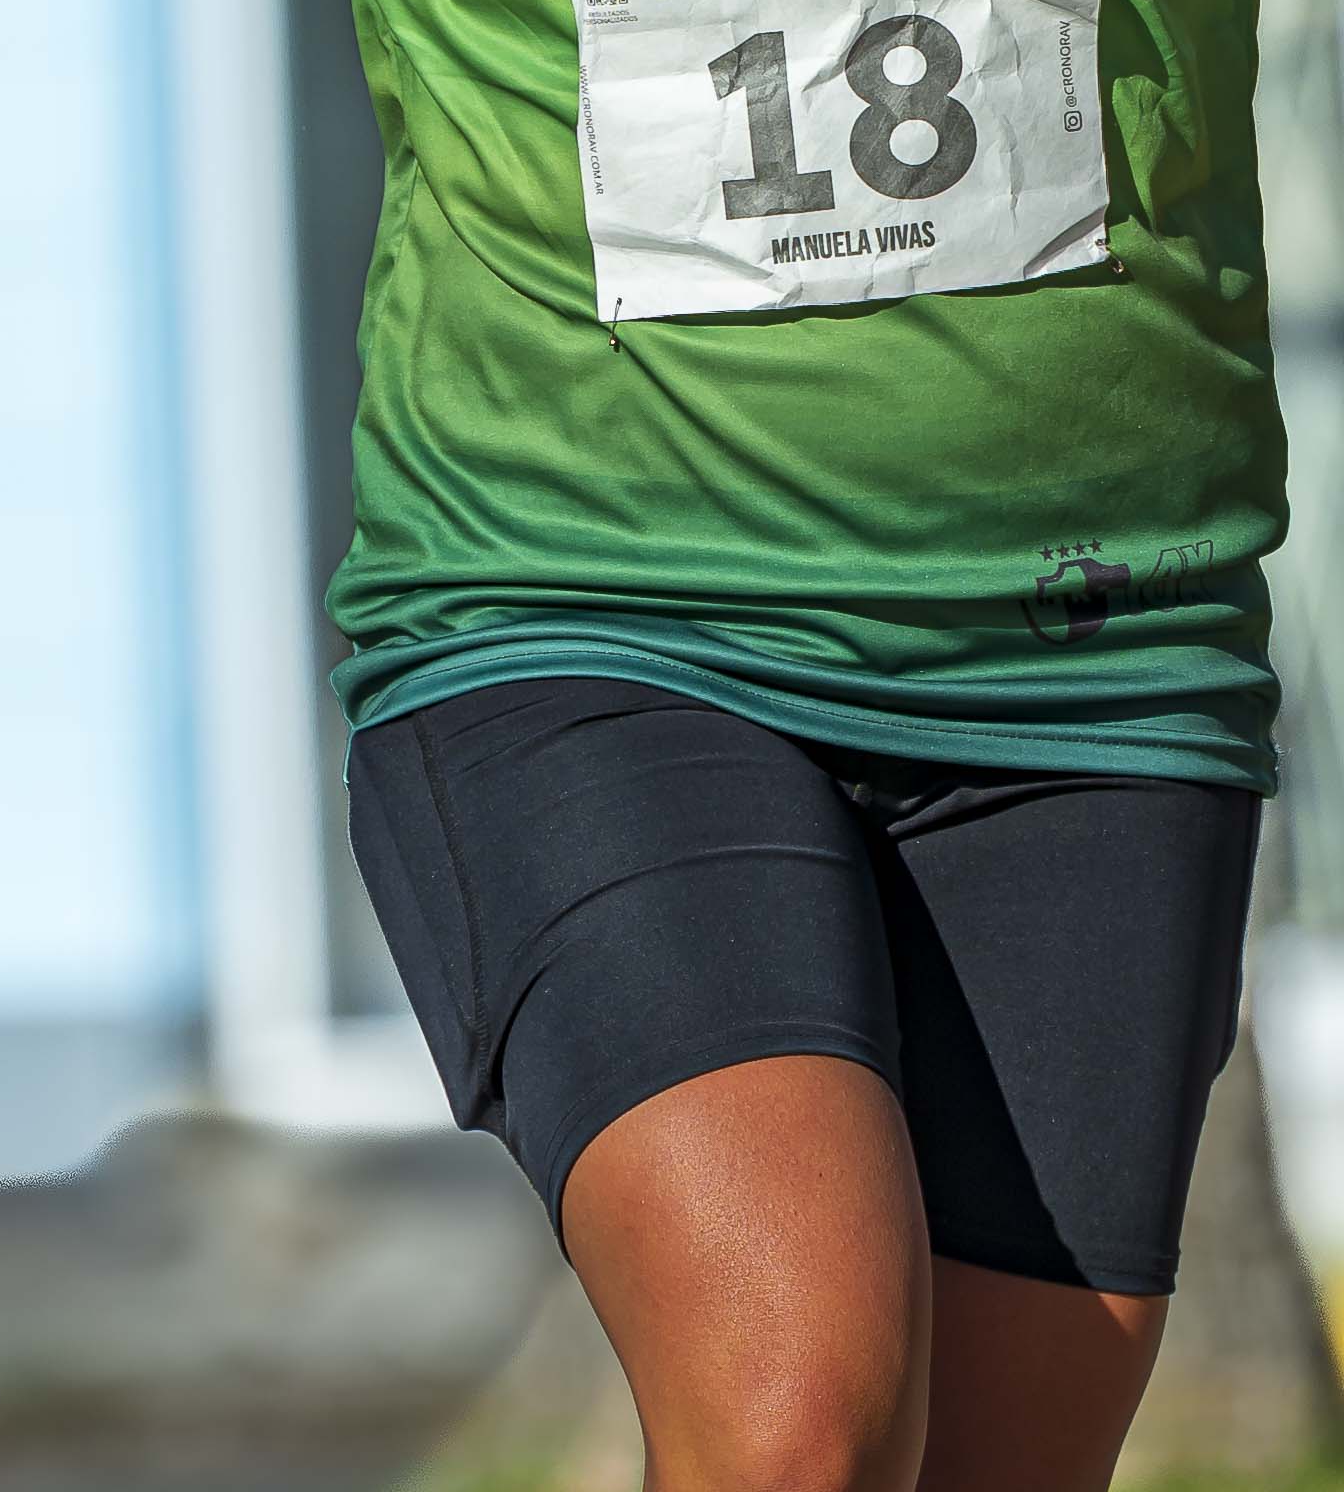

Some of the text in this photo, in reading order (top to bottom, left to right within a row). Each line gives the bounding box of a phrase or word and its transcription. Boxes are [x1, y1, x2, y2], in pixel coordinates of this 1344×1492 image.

[1059, 20, 1078, 108] @CRONORAV
[708, 14, 978, 221] 18
[771, 220, 936, 265] MANUELA VIVAS
